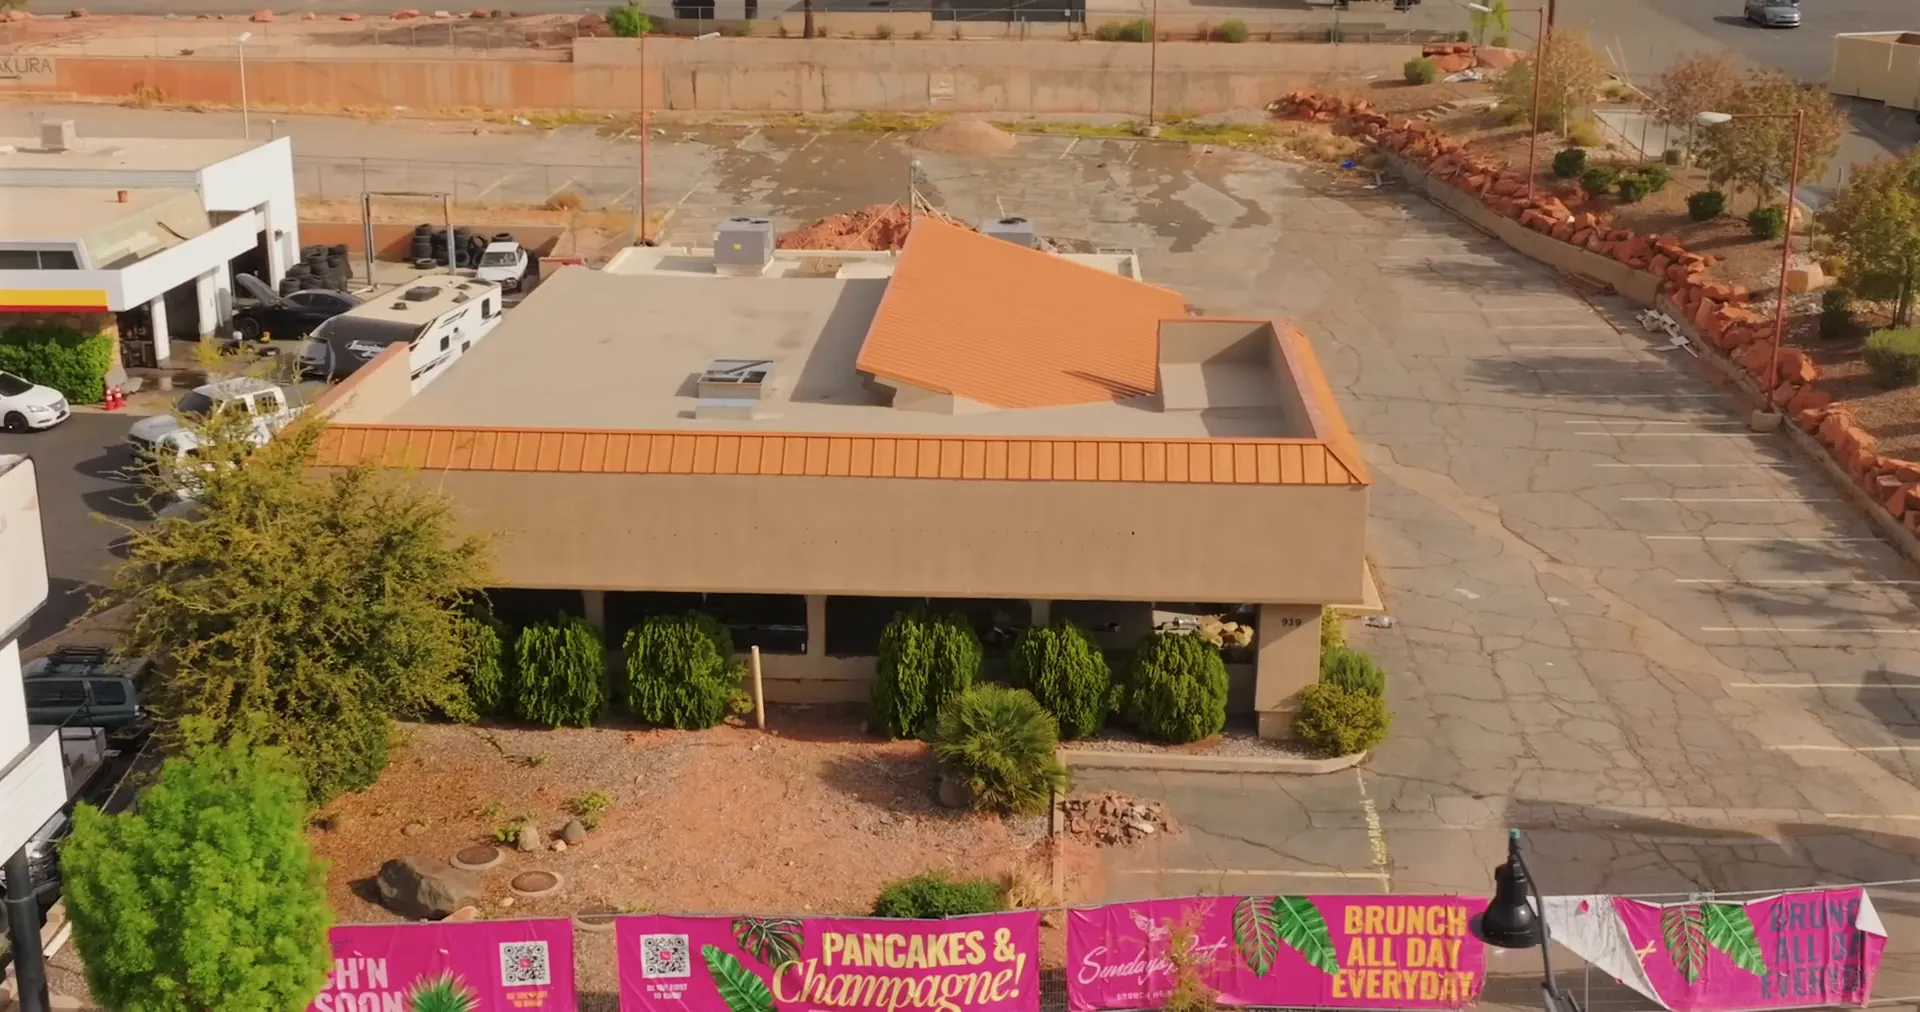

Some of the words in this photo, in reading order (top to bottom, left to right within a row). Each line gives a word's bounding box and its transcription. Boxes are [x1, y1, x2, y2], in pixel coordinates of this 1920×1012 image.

[0, 57, 53, 75] KURA
[1344, 905, 1466, 936] BRUNCH
[1771, 898, 1862, 932] BRUNC
[822, 931, 986, 969] PANCAKES
[993, 928, 1015, 962] &
[1347, 937, 1397, 967] ALL
[1407, 938, 1461, 969] DAY
[1776, 934, 1818, 964] ALL
[1831, 930, 1866, 961] DA
[772, 953, 1026, 1012] Champagne!
[1332, 969, 1475, 1001] EVERYDAY
[315, 991, 404, 1012] SOON
